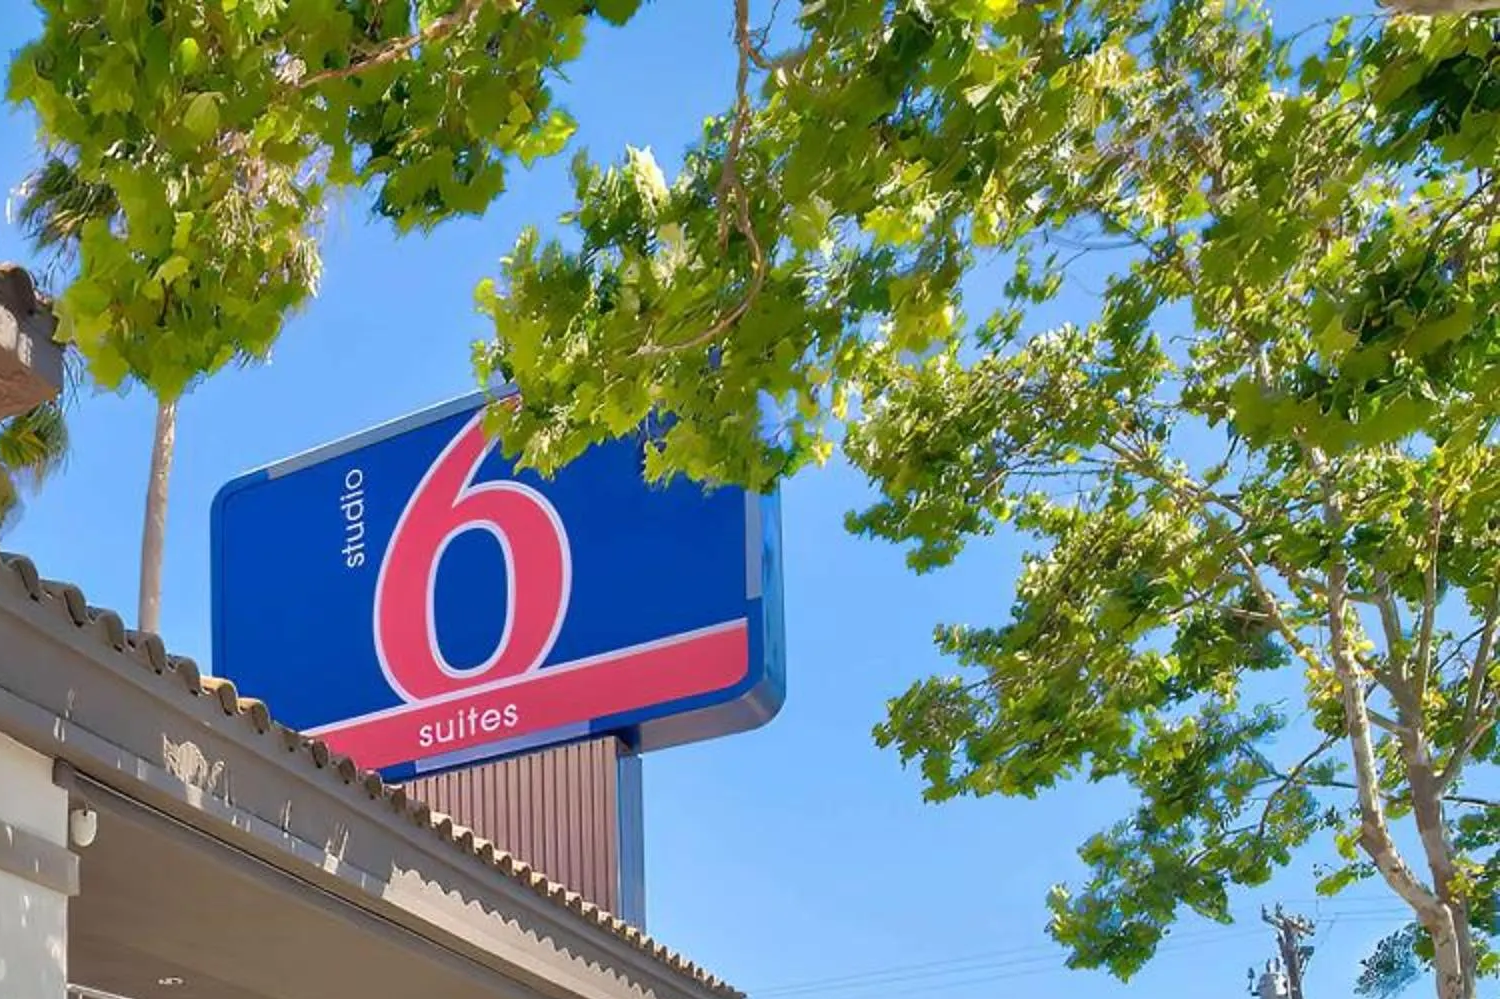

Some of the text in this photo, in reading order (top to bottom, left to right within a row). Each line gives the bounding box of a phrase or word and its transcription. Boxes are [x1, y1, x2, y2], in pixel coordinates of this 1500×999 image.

[340, 469, 365, 567] studio
[373, 392, 573, 703] 6
[418, 702, 520, 748] suites
